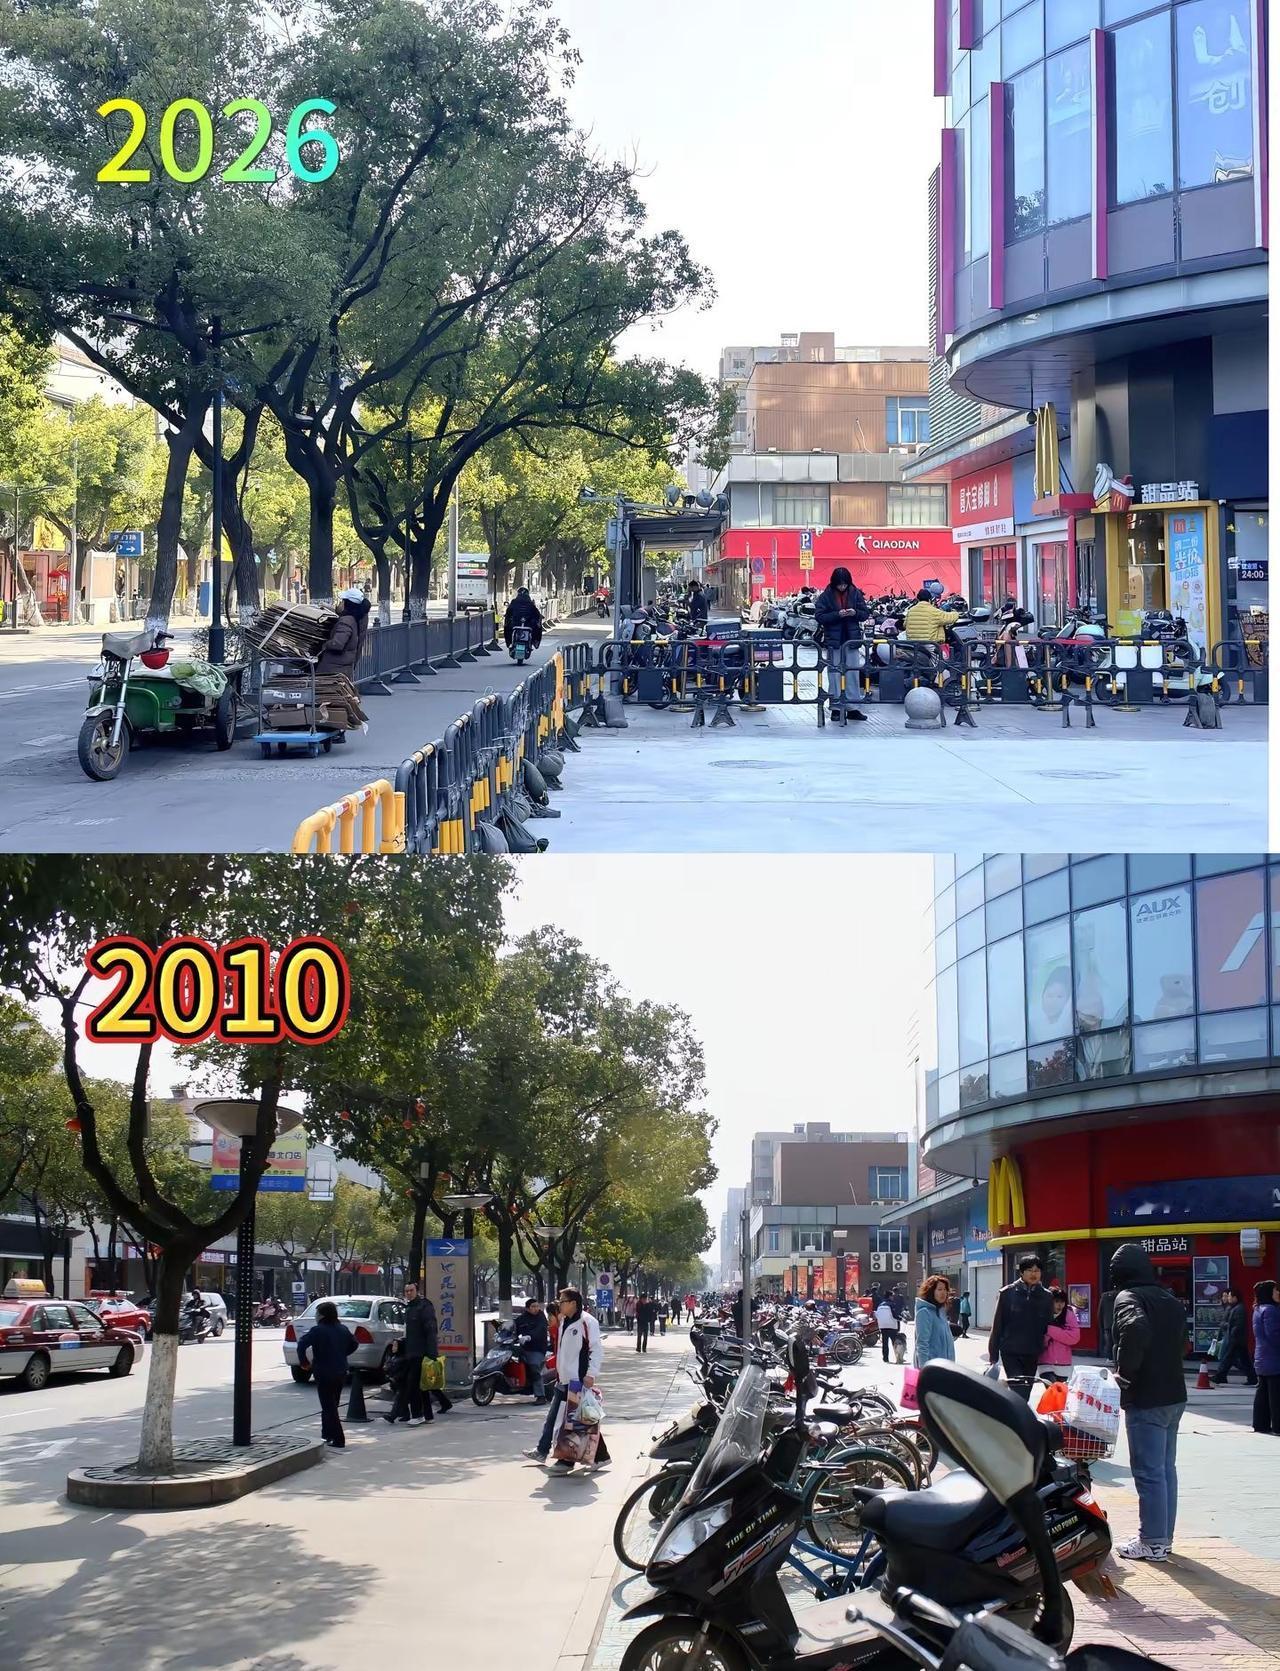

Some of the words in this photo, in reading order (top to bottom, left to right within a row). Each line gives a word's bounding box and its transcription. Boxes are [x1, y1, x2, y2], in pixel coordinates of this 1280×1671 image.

[1141, 480, 1199, 504] 甜品站
[801, 532, 810, 549] P
[873, 540, 919, 549] QIAODAN
[1241, 570, 1264, 579] 24:00
[1136, 895, 1181, 917] AUX
[1140, 1237, 1188, 1252] 甜品站
[725, 1532, 745, 1549] TIDE
[757, 1504, 778, 1524] TIME
